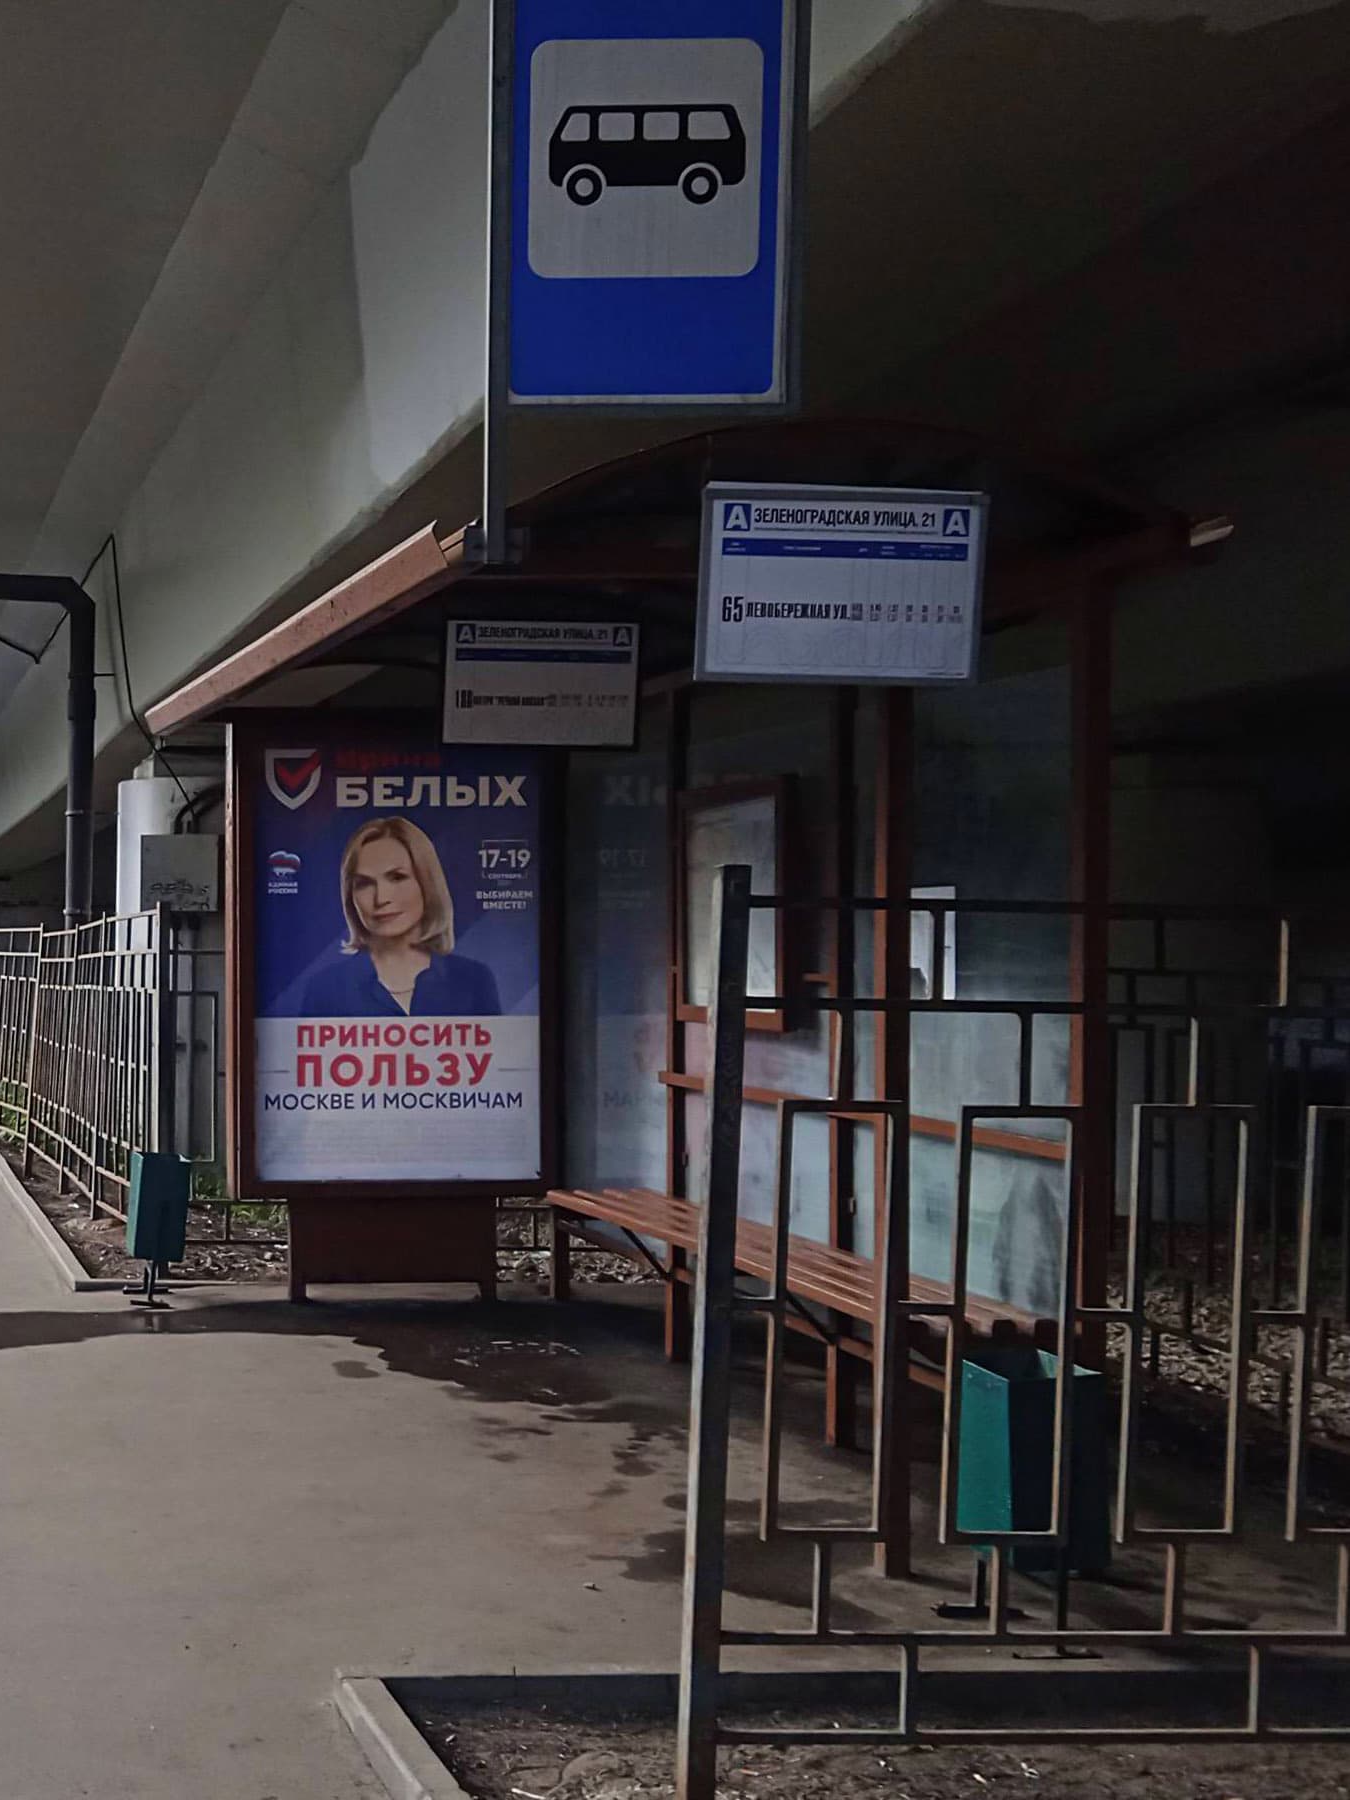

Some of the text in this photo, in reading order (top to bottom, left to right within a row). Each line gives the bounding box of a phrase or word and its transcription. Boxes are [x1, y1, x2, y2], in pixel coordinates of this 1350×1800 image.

[754, 507, 870, 528] ЗЕЛЕНОГРАДСКАЯ
[921, 512, 936, 527] 21
[722, 596, 744, 622] 65
[746, 602, 831, 619] ЛЕВОБЕРЕЖНАЯ
[833, 603, 851, 619] УЛ.
[336, 776, 527, 807] БЕЛЫХ
[478, 849, 531, 868] 17-19
[476, 890, 534, 900] ВЫБИРАЕМ
[297, 1023, 492, 1048] ПРИНОСИТЬ
[296, 1053, 493, 1088] ПОЛЬЗУ
[264, 1092, 523, 1110] МОСКВЕ И МОСКВИЧАМ
